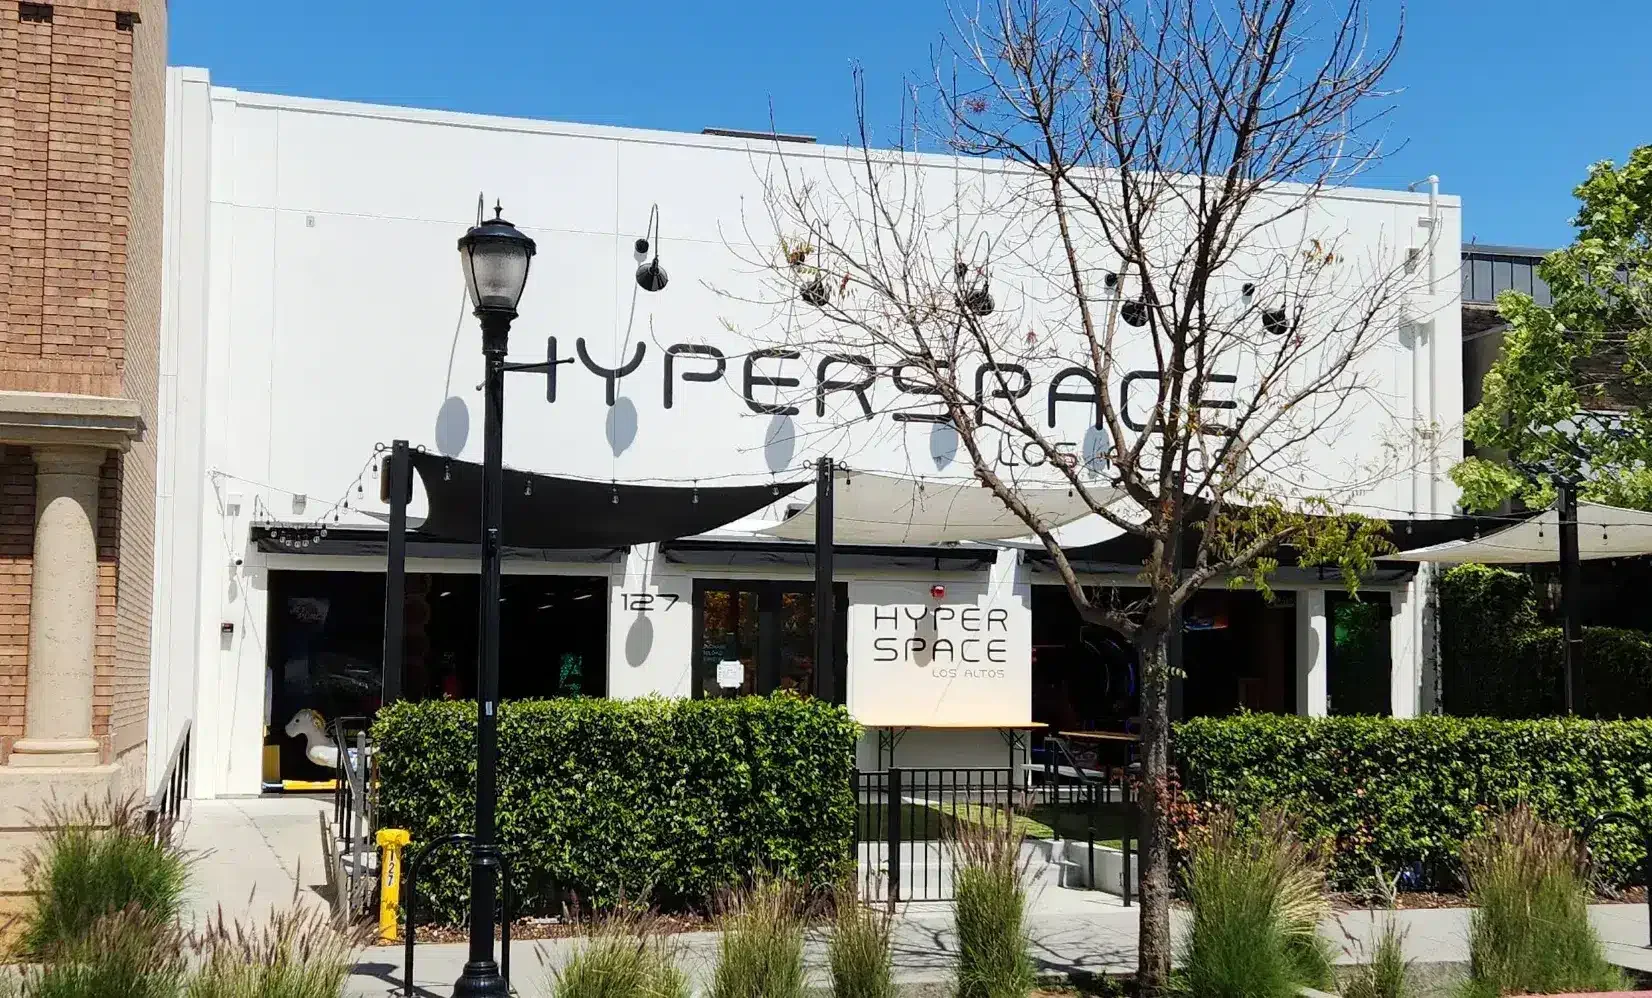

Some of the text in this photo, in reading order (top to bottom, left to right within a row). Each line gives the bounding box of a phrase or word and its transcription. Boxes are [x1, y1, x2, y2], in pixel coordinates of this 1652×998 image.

[502, 336, 1238, 437] HYPERSPACE
[621, 593, 680, 611] 127
[874, 606, 1008, 632] HYPER
[873, 637, 1007, 663] SPACE
[932, 669, 1005, 679] LOS ALTOS
[387, 849, 395, 887] 127
